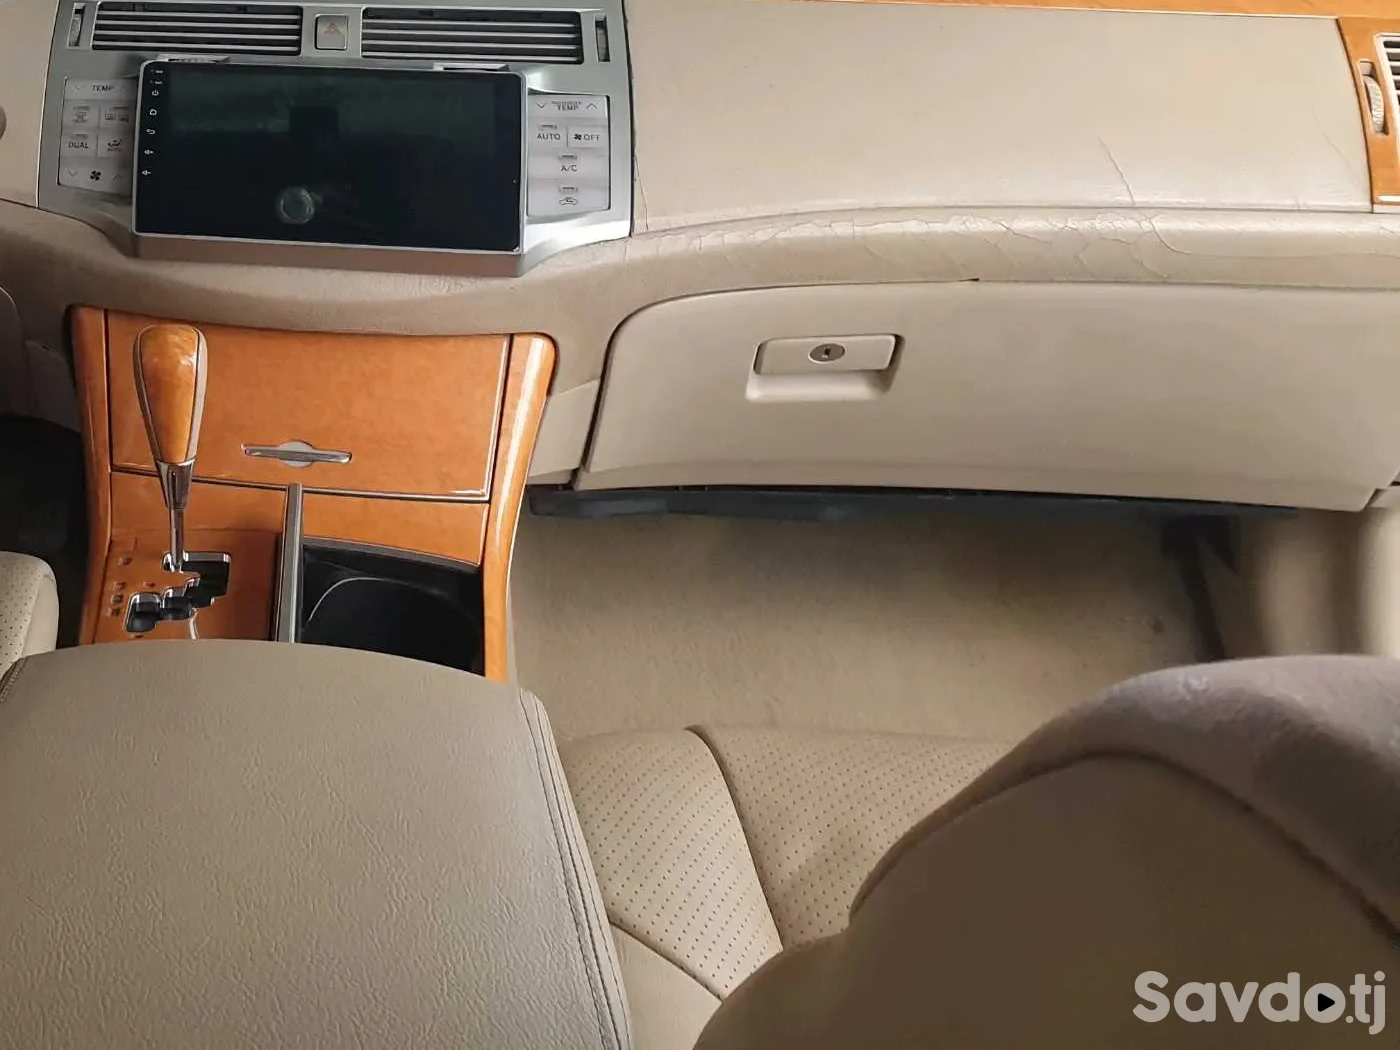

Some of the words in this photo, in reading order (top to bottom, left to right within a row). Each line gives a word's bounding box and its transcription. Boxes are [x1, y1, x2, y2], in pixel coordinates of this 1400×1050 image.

[536, 133, 561, 141] AUTO
[583, 133, 600, 141] OFF
[68, 141, 89, 149] DUAL
[560, 164, 578, 172] A/C
